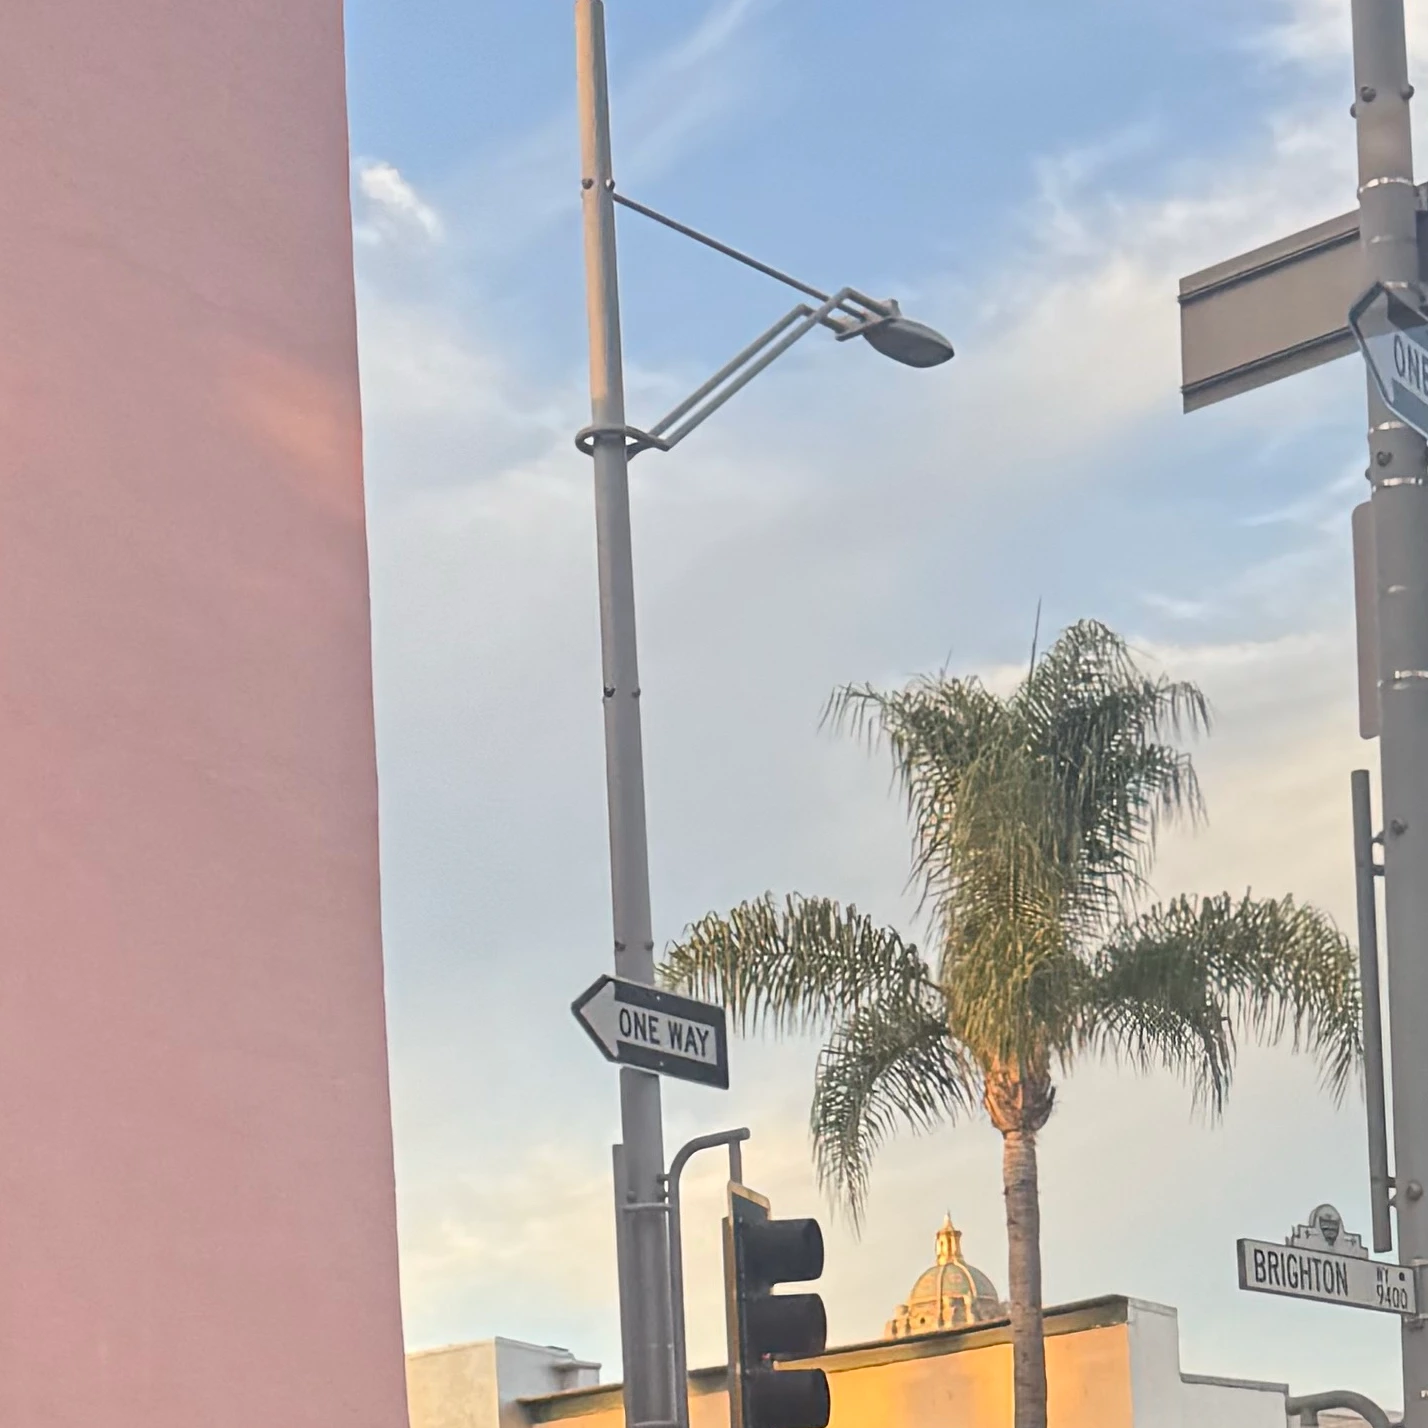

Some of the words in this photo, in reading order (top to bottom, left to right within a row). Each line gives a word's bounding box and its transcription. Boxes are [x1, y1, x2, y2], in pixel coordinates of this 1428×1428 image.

[619, 1008, 660, 1044] ONE
[668, 1020, 709, 1057] WAY
[1253, 1248, 1349, 1297] BRIGHTON
[1376, 1284, 1408, 1309] 9400
